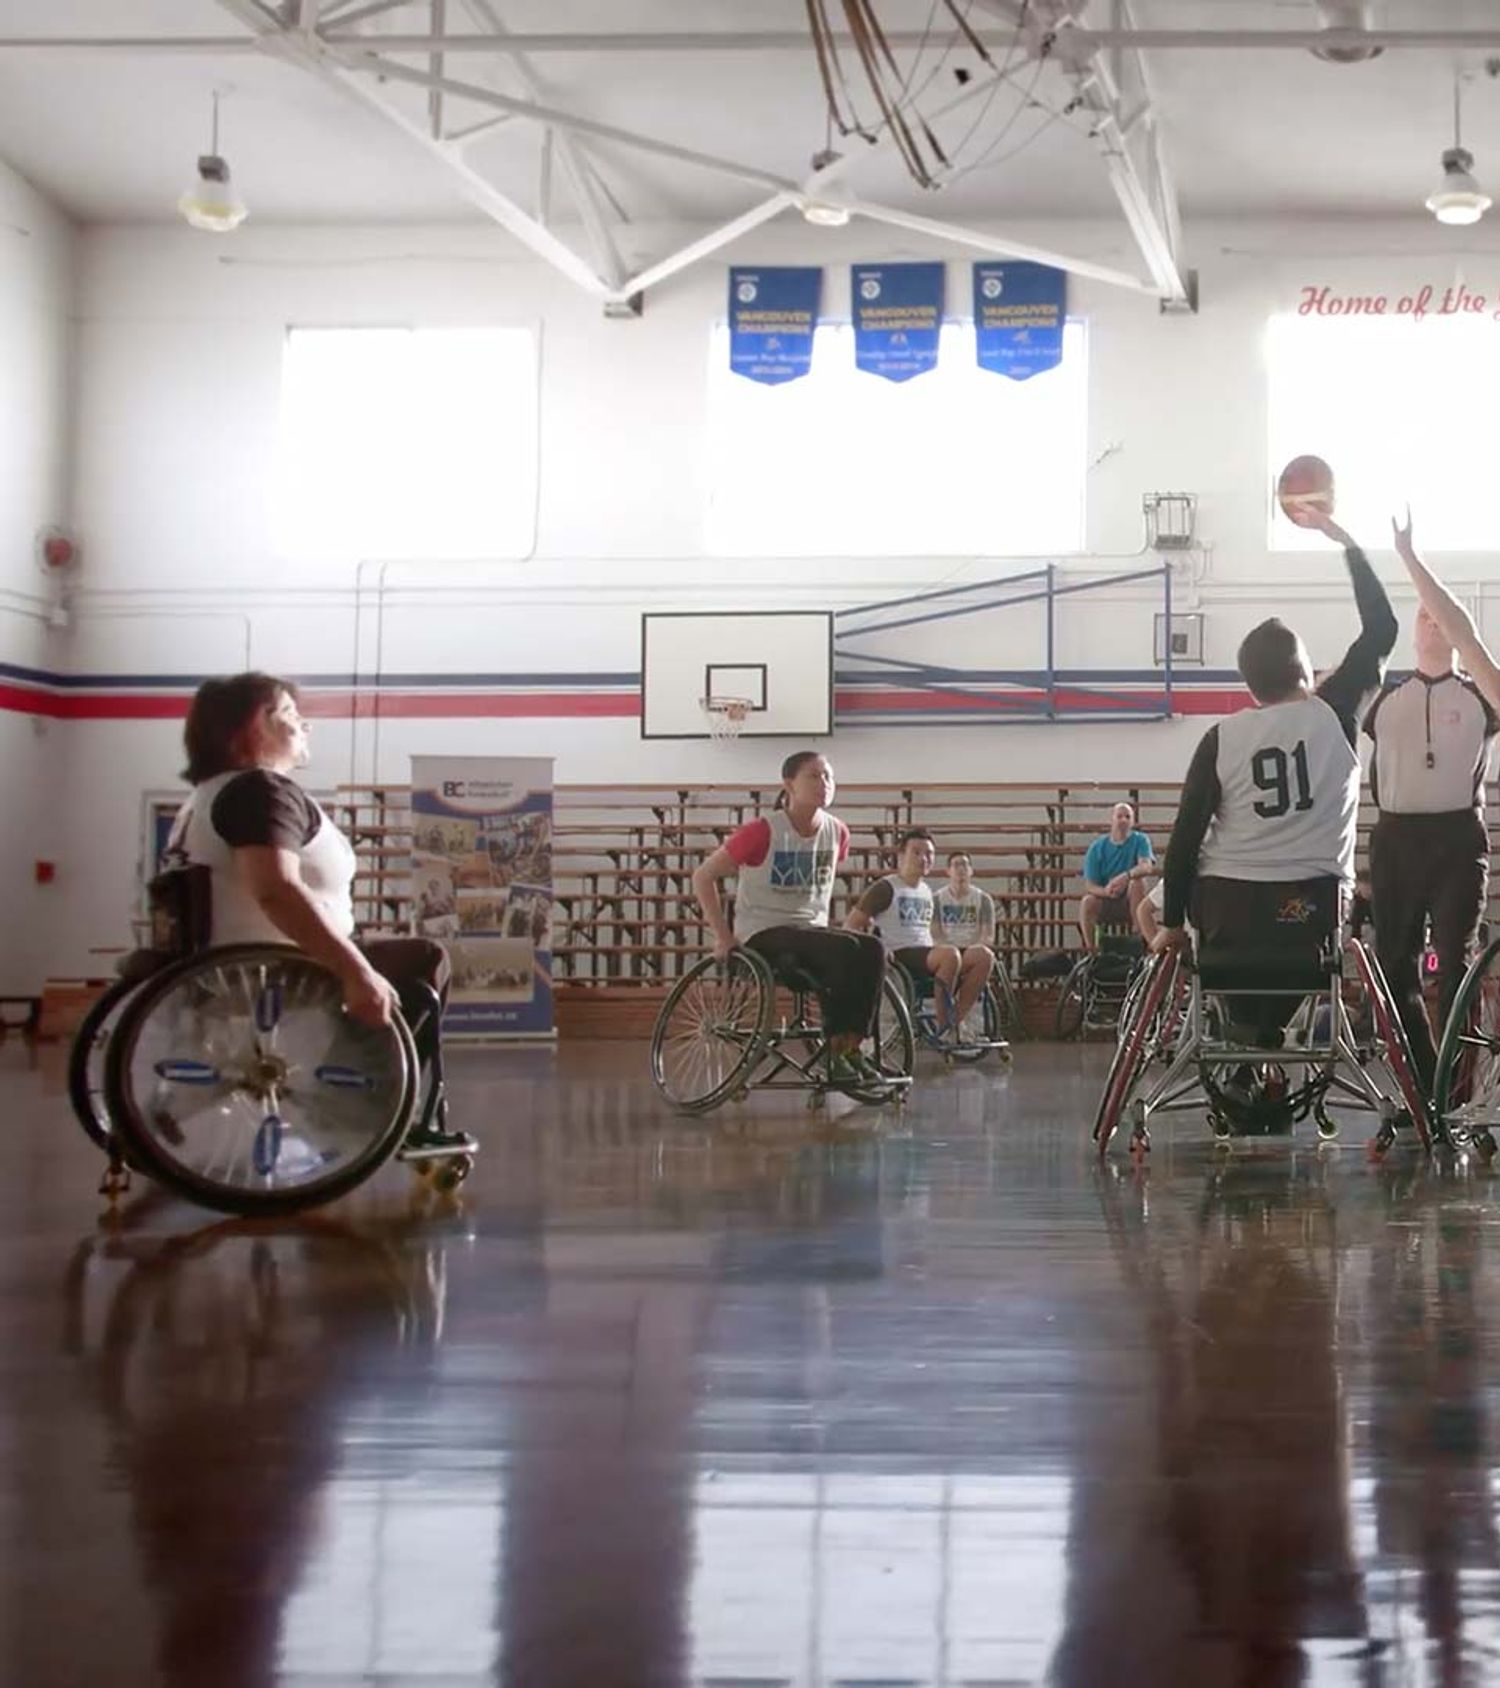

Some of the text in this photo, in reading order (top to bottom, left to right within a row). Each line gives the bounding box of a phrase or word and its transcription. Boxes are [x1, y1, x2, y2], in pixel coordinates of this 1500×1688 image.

[1299, 286, 1387, 315] Home
[1396, 285, 1433, 321] of
[1437, 285, 1486, 314] the
[443, 781, 465, 798] BC
[1252, 739, 1314, 819] 91
